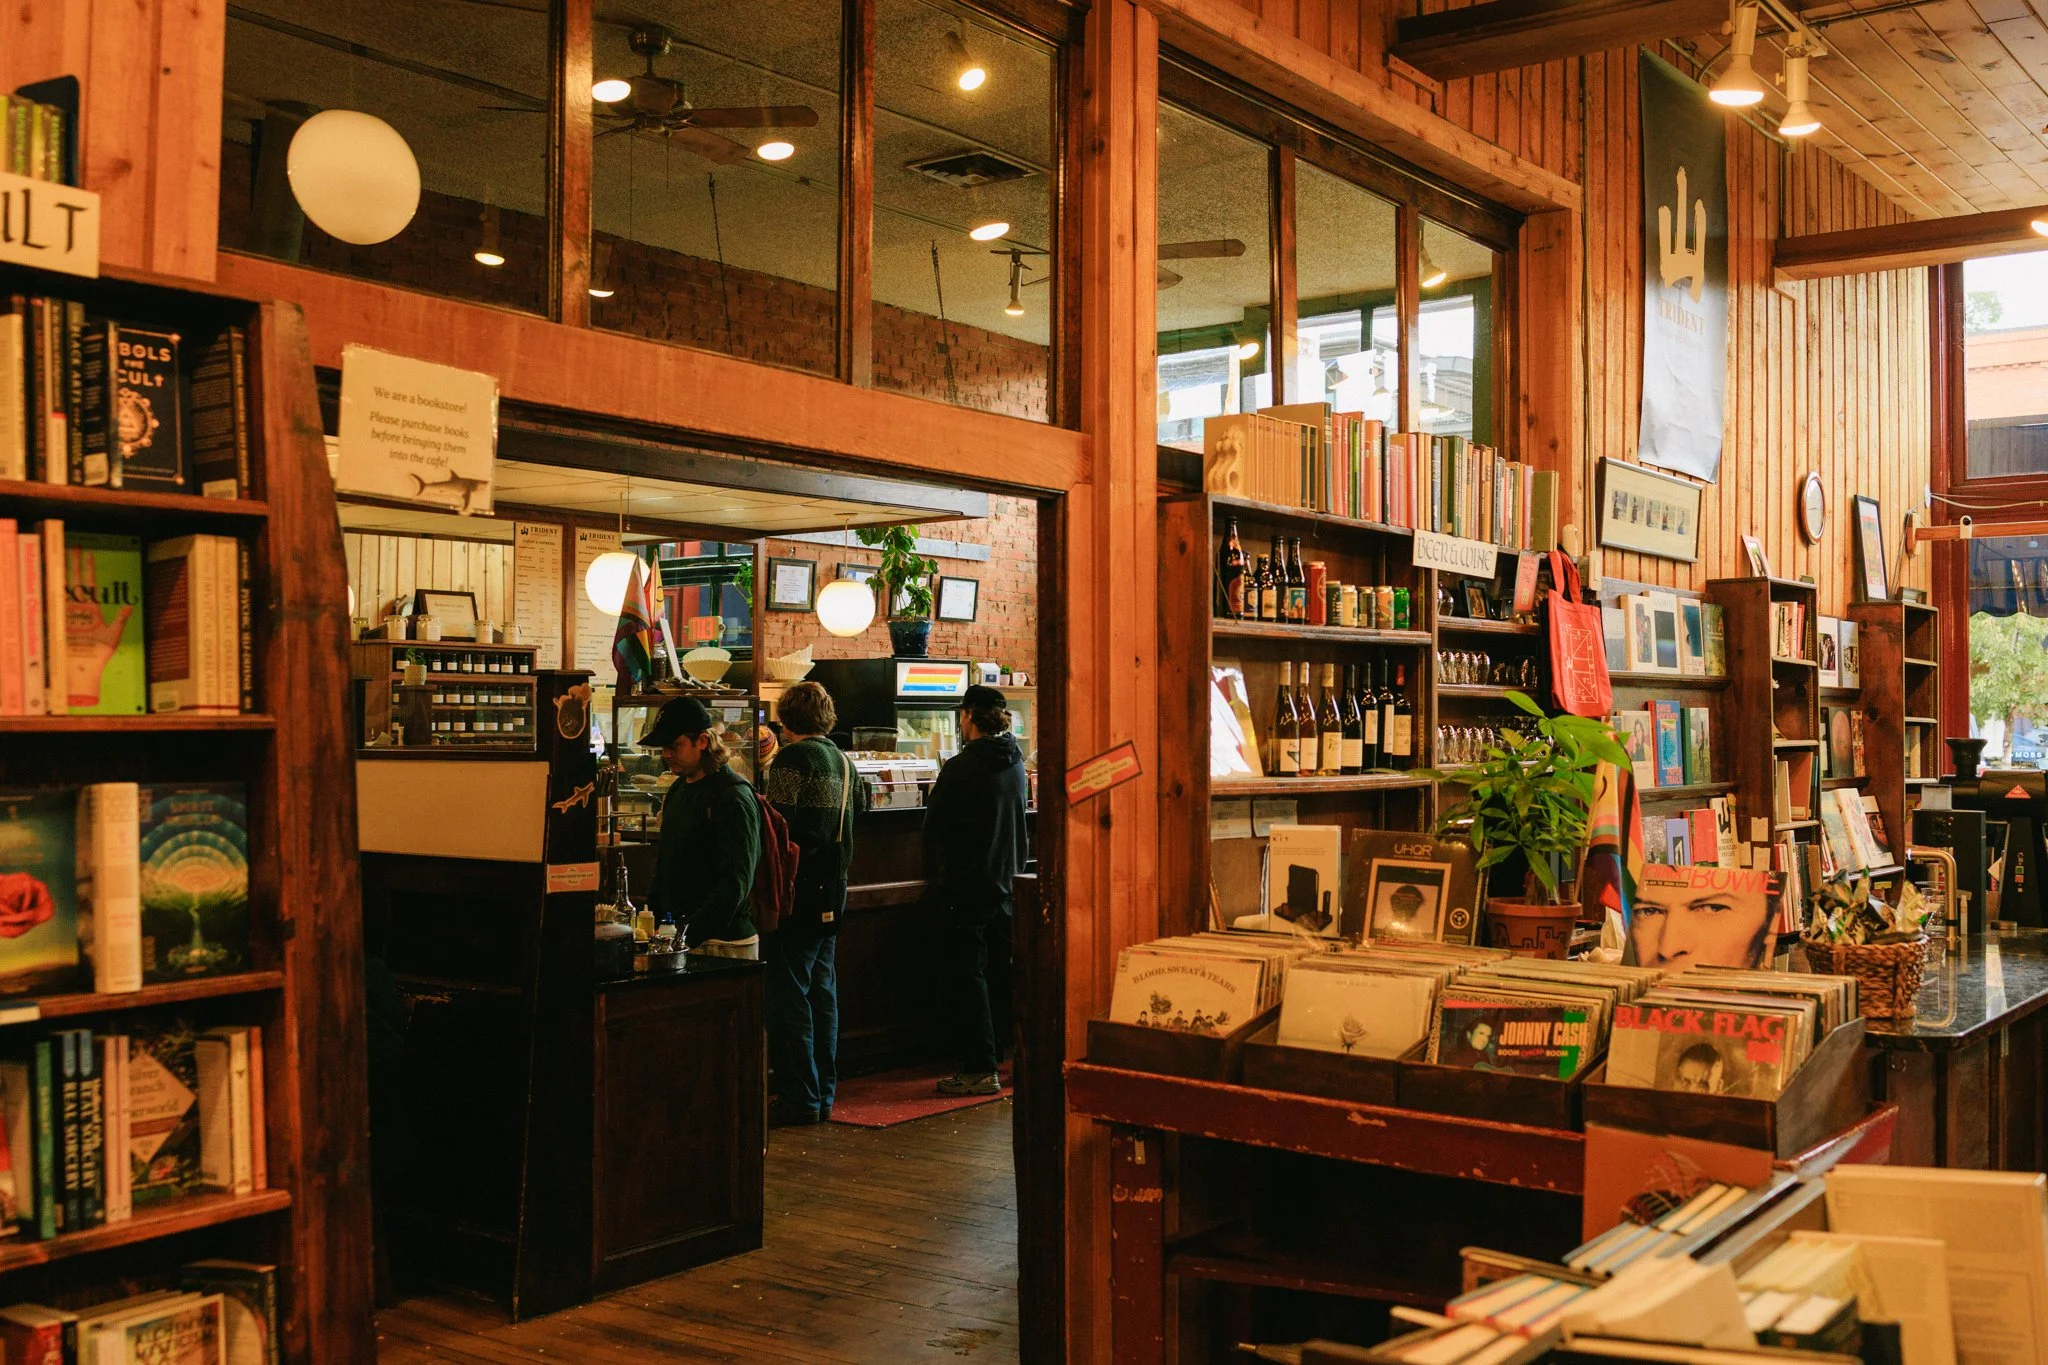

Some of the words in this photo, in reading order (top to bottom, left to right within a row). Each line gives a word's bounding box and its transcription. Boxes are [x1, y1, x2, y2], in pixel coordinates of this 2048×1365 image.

[1659, 297, 1704, 335] TRIDENT
[119, 342, 171, 361] BOLS
[374, 386, 389, 399] We
[391, 392, 407, 402] are
[417, 394, 467, 414] bookstore!
[369, 411, 399, 427] Please
[401, 418, 442, 436] purchase
[444, 423, 469, 440] books
[371, 428, 401, 443] before
[402, 434, 441, 452] bringing
[443, 443, 467, 454] them
[389, 449, 407, 461] into
[410, 452, 424, 463] the
[530, 526, 558, 535] TRIDENT
[1417, 537, 1448, 563] BEER
[1449, 544, 1459, 566] &
[1460, 546, 1493, 571] WINE
[1133, 966, 1167, 984] BLOOD,
[1167, 966, 1200, 975] SWEAT
[1206, 971, 1237, 994] TEARS
[1500, 1021, 1552, 1046] JOHNNY
[1553, 1021, 1588, 1046] CASH
[1615, 1005, 1705, 1036] BLACK
[1712, 1012, 1785, 1041] FLAG
[63, 1082, 77, 1120] REAL
